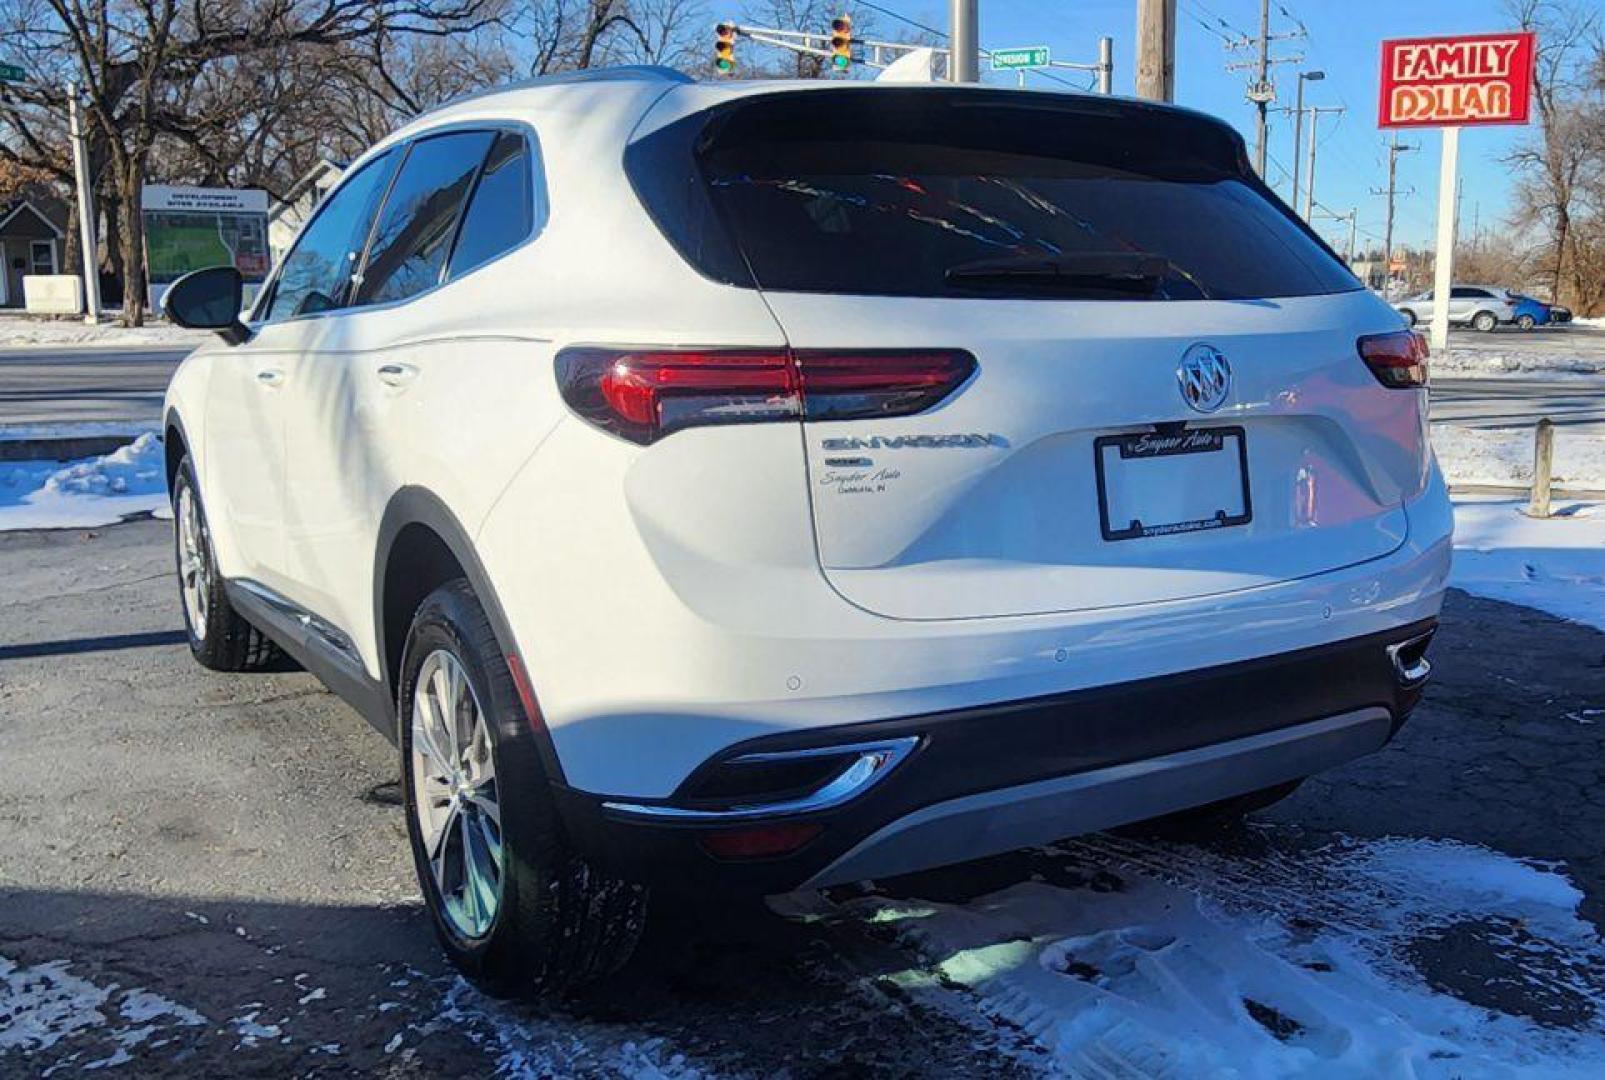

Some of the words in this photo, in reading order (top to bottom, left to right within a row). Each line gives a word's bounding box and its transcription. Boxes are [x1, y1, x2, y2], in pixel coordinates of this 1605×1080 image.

[1393, 40, 1519, 80] FAMILY
[1391, 80, 1511, 122] DOLLAR
[821, 434, 1011, 450] ENVISION
